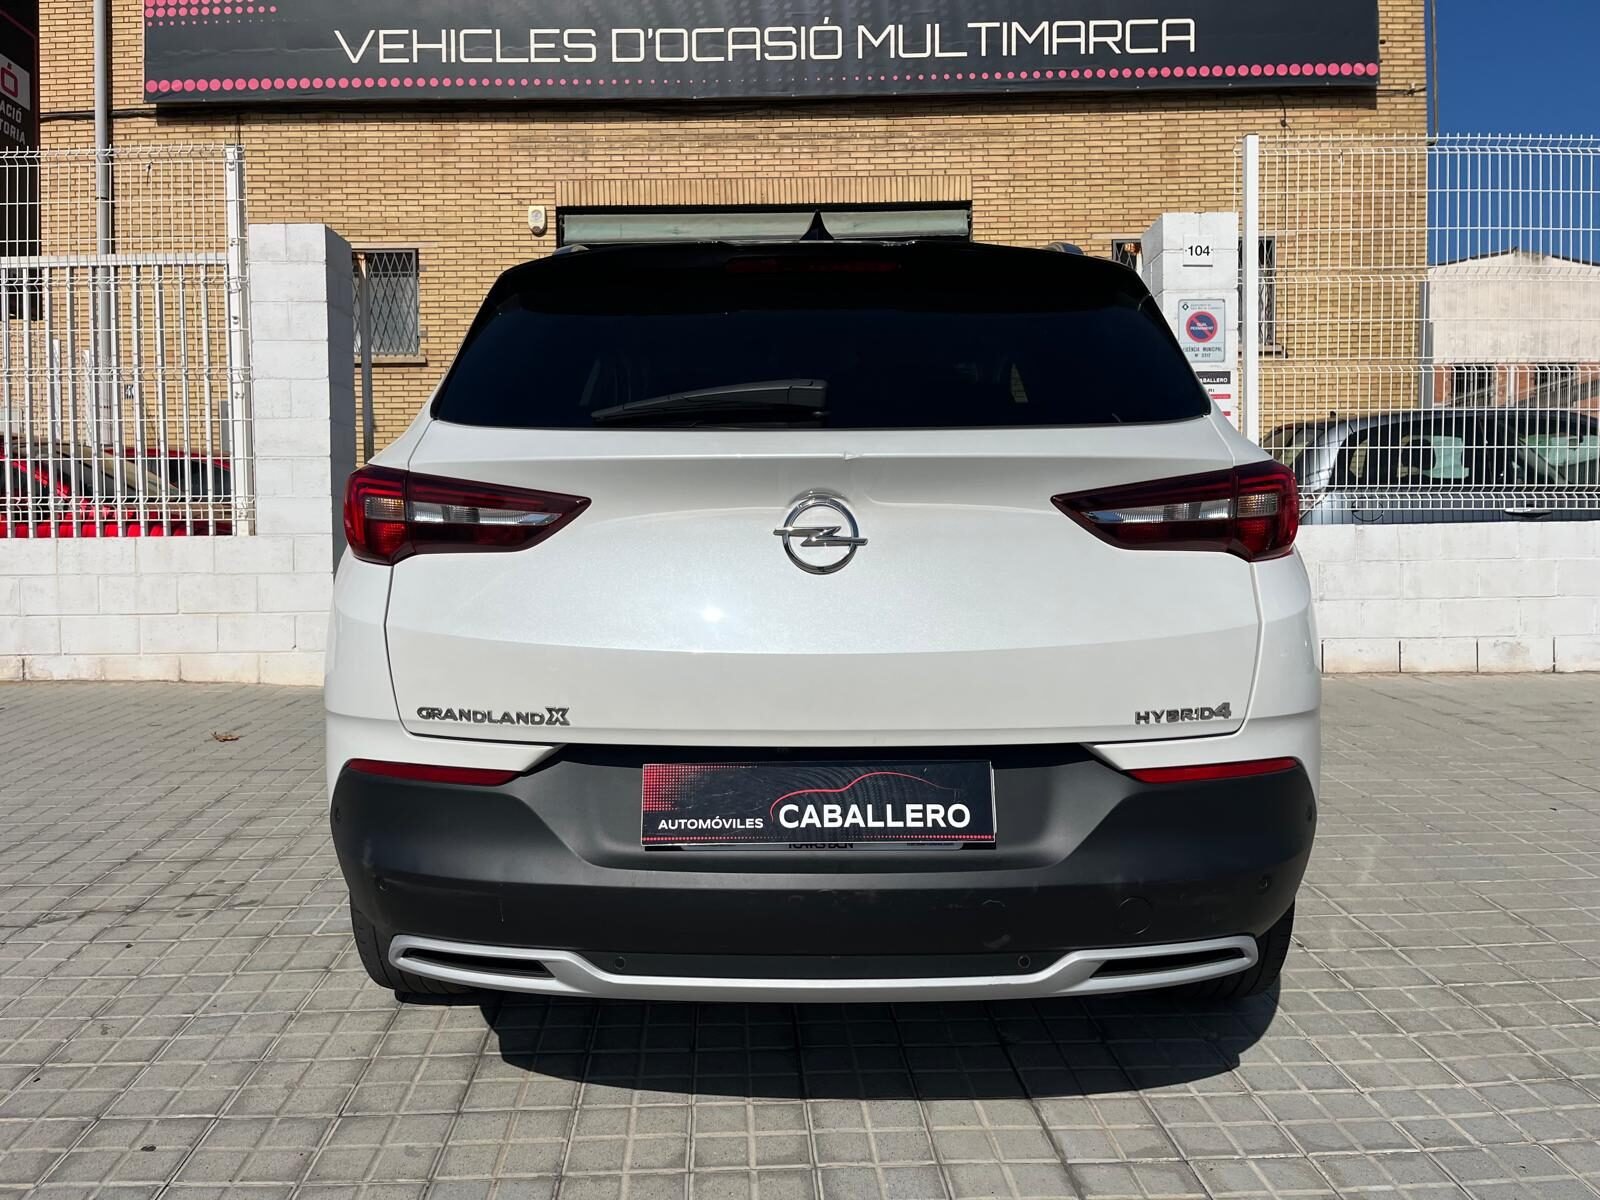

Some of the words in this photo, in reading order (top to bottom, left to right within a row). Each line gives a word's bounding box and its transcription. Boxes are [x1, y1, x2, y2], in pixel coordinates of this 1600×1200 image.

[334, 28, 597, 64] VEHICLES
[611, 17, 843, 64] D'OCASIÓ
[857, 18, 1196, 60] MULTIMARCA
[1187, 245, 1211, 256] 104
[1134, 702, 1232, 725] HYBRID4
[657, 815, 764, 831] AUTOMÓVILES
[778, 803, 971, 829] CABALLERO
